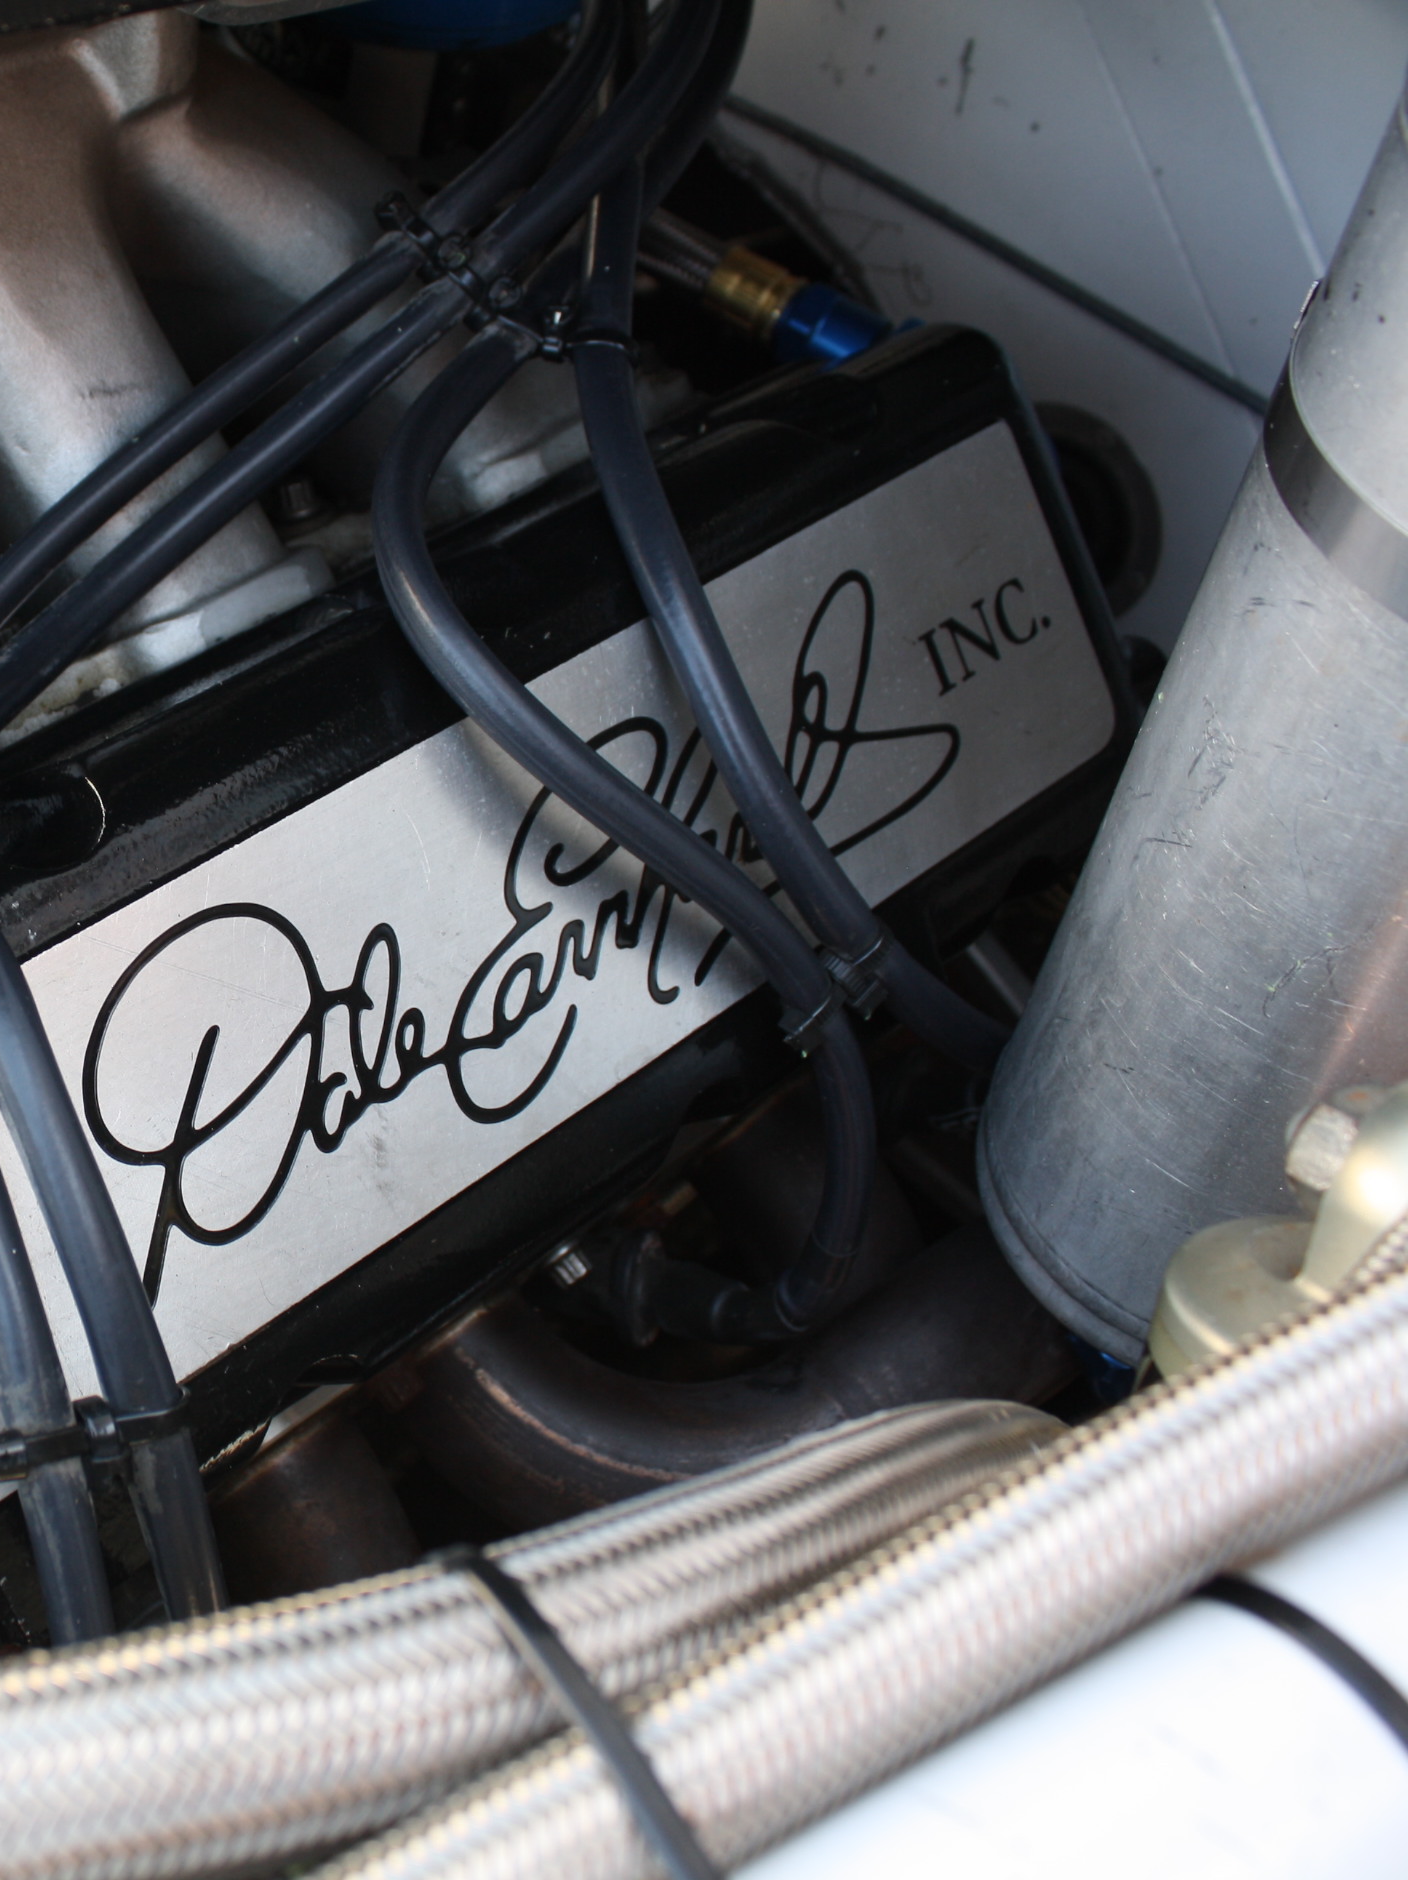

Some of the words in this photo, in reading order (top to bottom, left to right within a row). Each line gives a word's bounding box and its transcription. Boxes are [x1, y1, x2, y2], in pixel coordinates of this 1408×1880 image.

[81, 902, 448, 1310] Dale
[442, 569, 960, 1124] Earnhrt
[917, 577, 1052, 697] INC.
